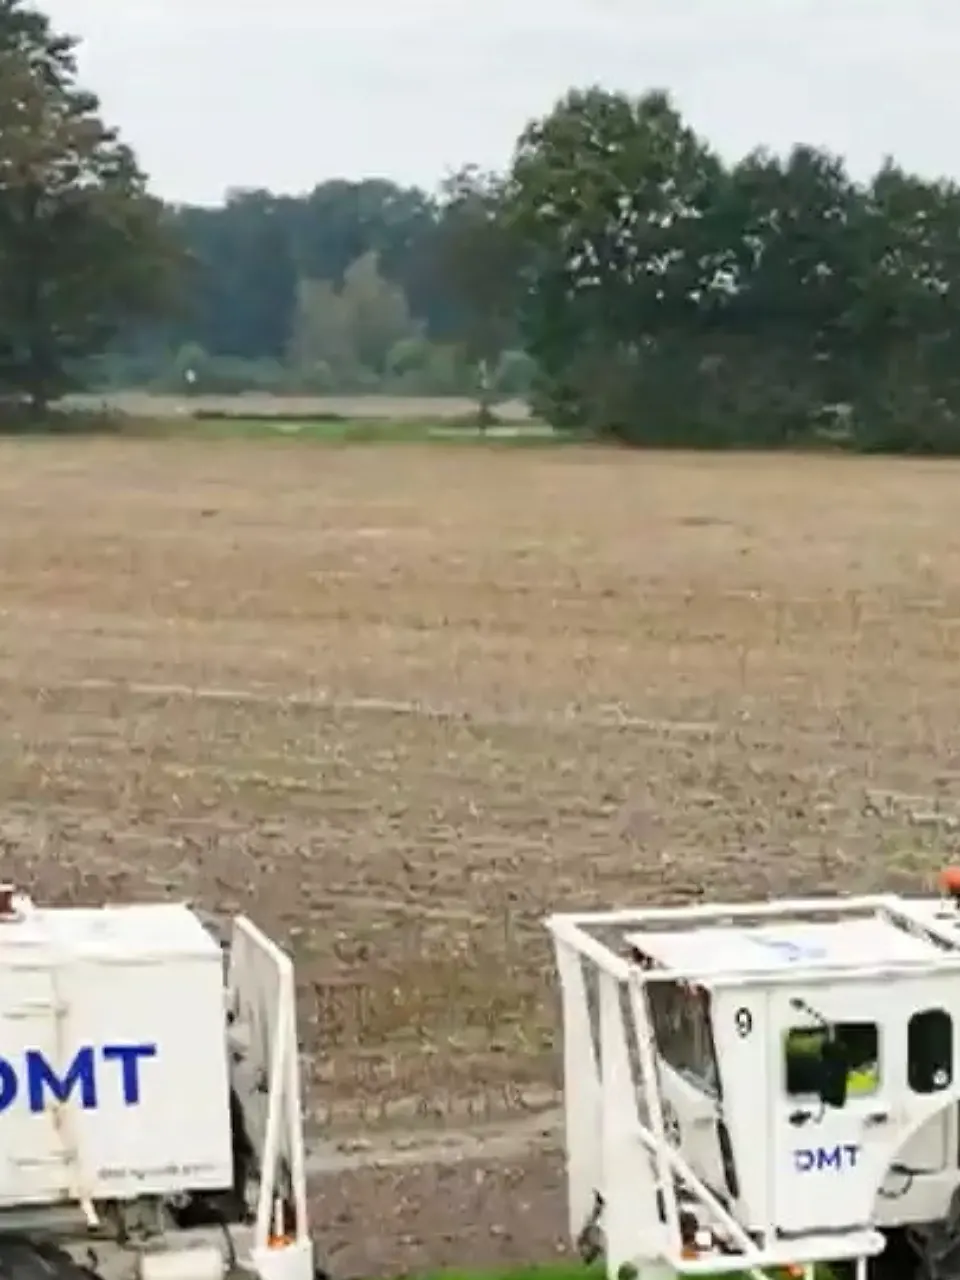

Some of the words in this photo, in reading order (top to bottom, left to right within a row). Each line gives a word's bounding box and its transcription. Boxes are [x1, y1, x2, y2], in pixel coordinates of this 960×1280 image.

[734, 1007, 752, 1039] 9
[0, 1044, 156, 1113] MT
[794, 1144, 862, 1171] DMT
